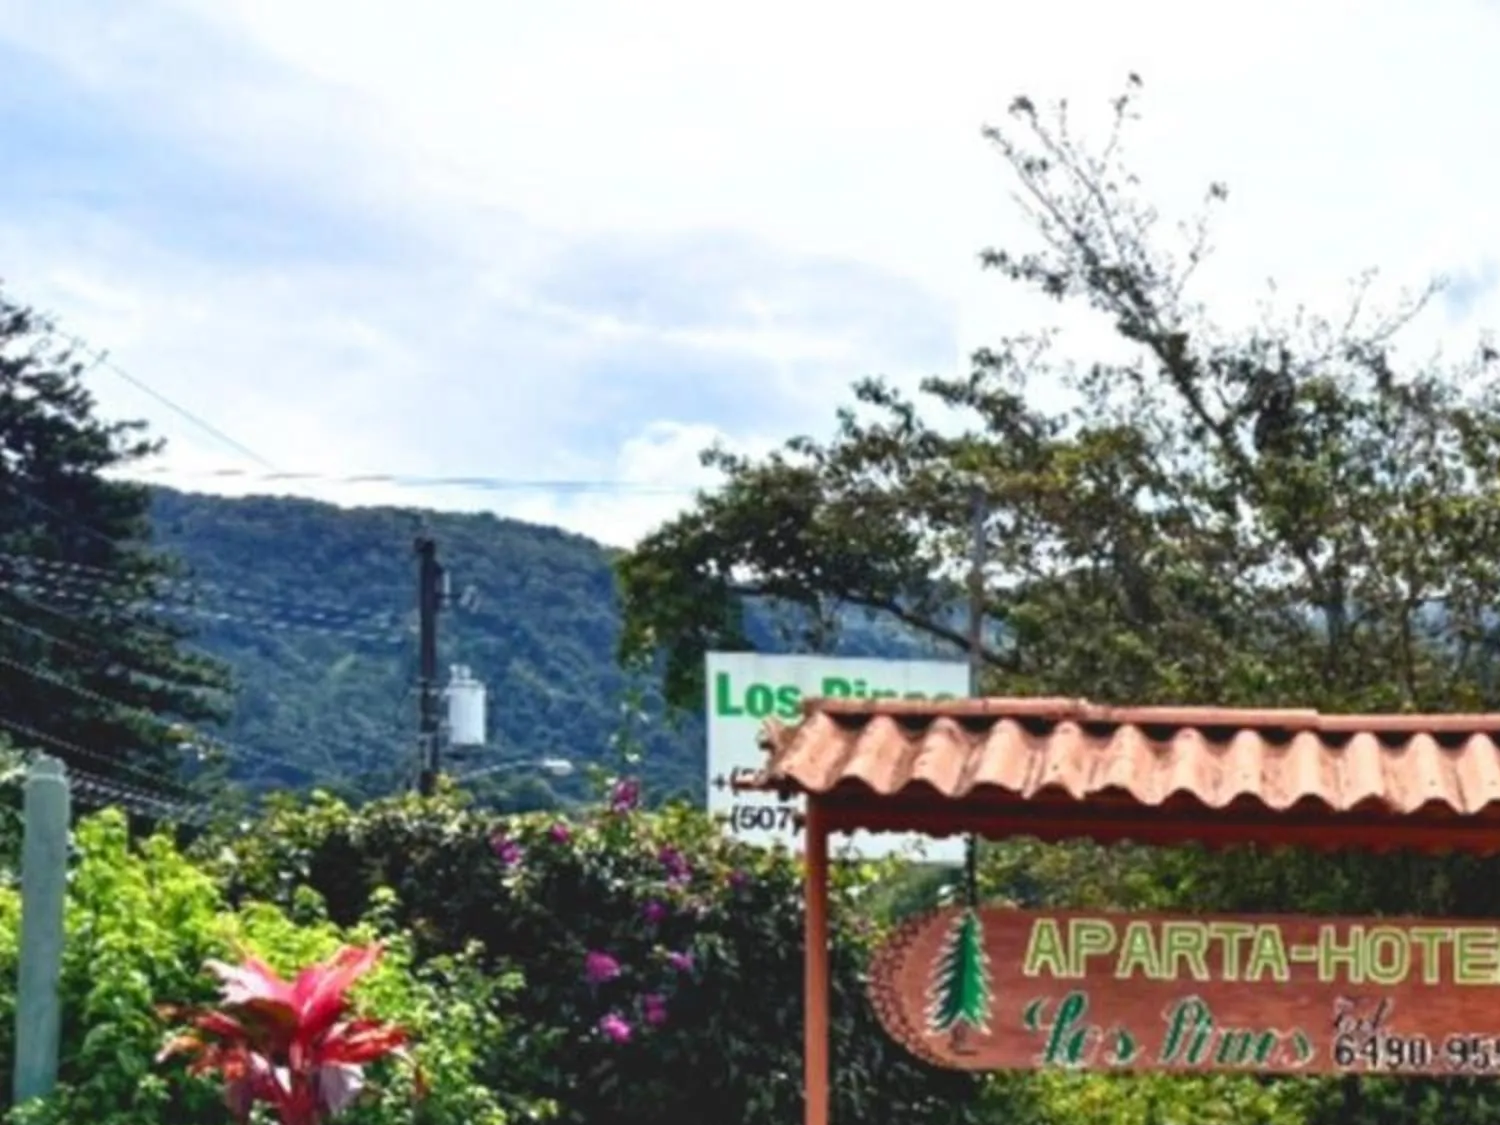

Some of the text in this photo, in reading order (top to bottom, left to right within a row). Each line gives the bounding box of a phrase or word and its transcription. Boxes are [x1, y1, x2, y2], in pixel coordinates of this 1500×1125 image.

[715, 671, 802, 719] Los
[1023, 989, 1317, 1068] Los Pinos
